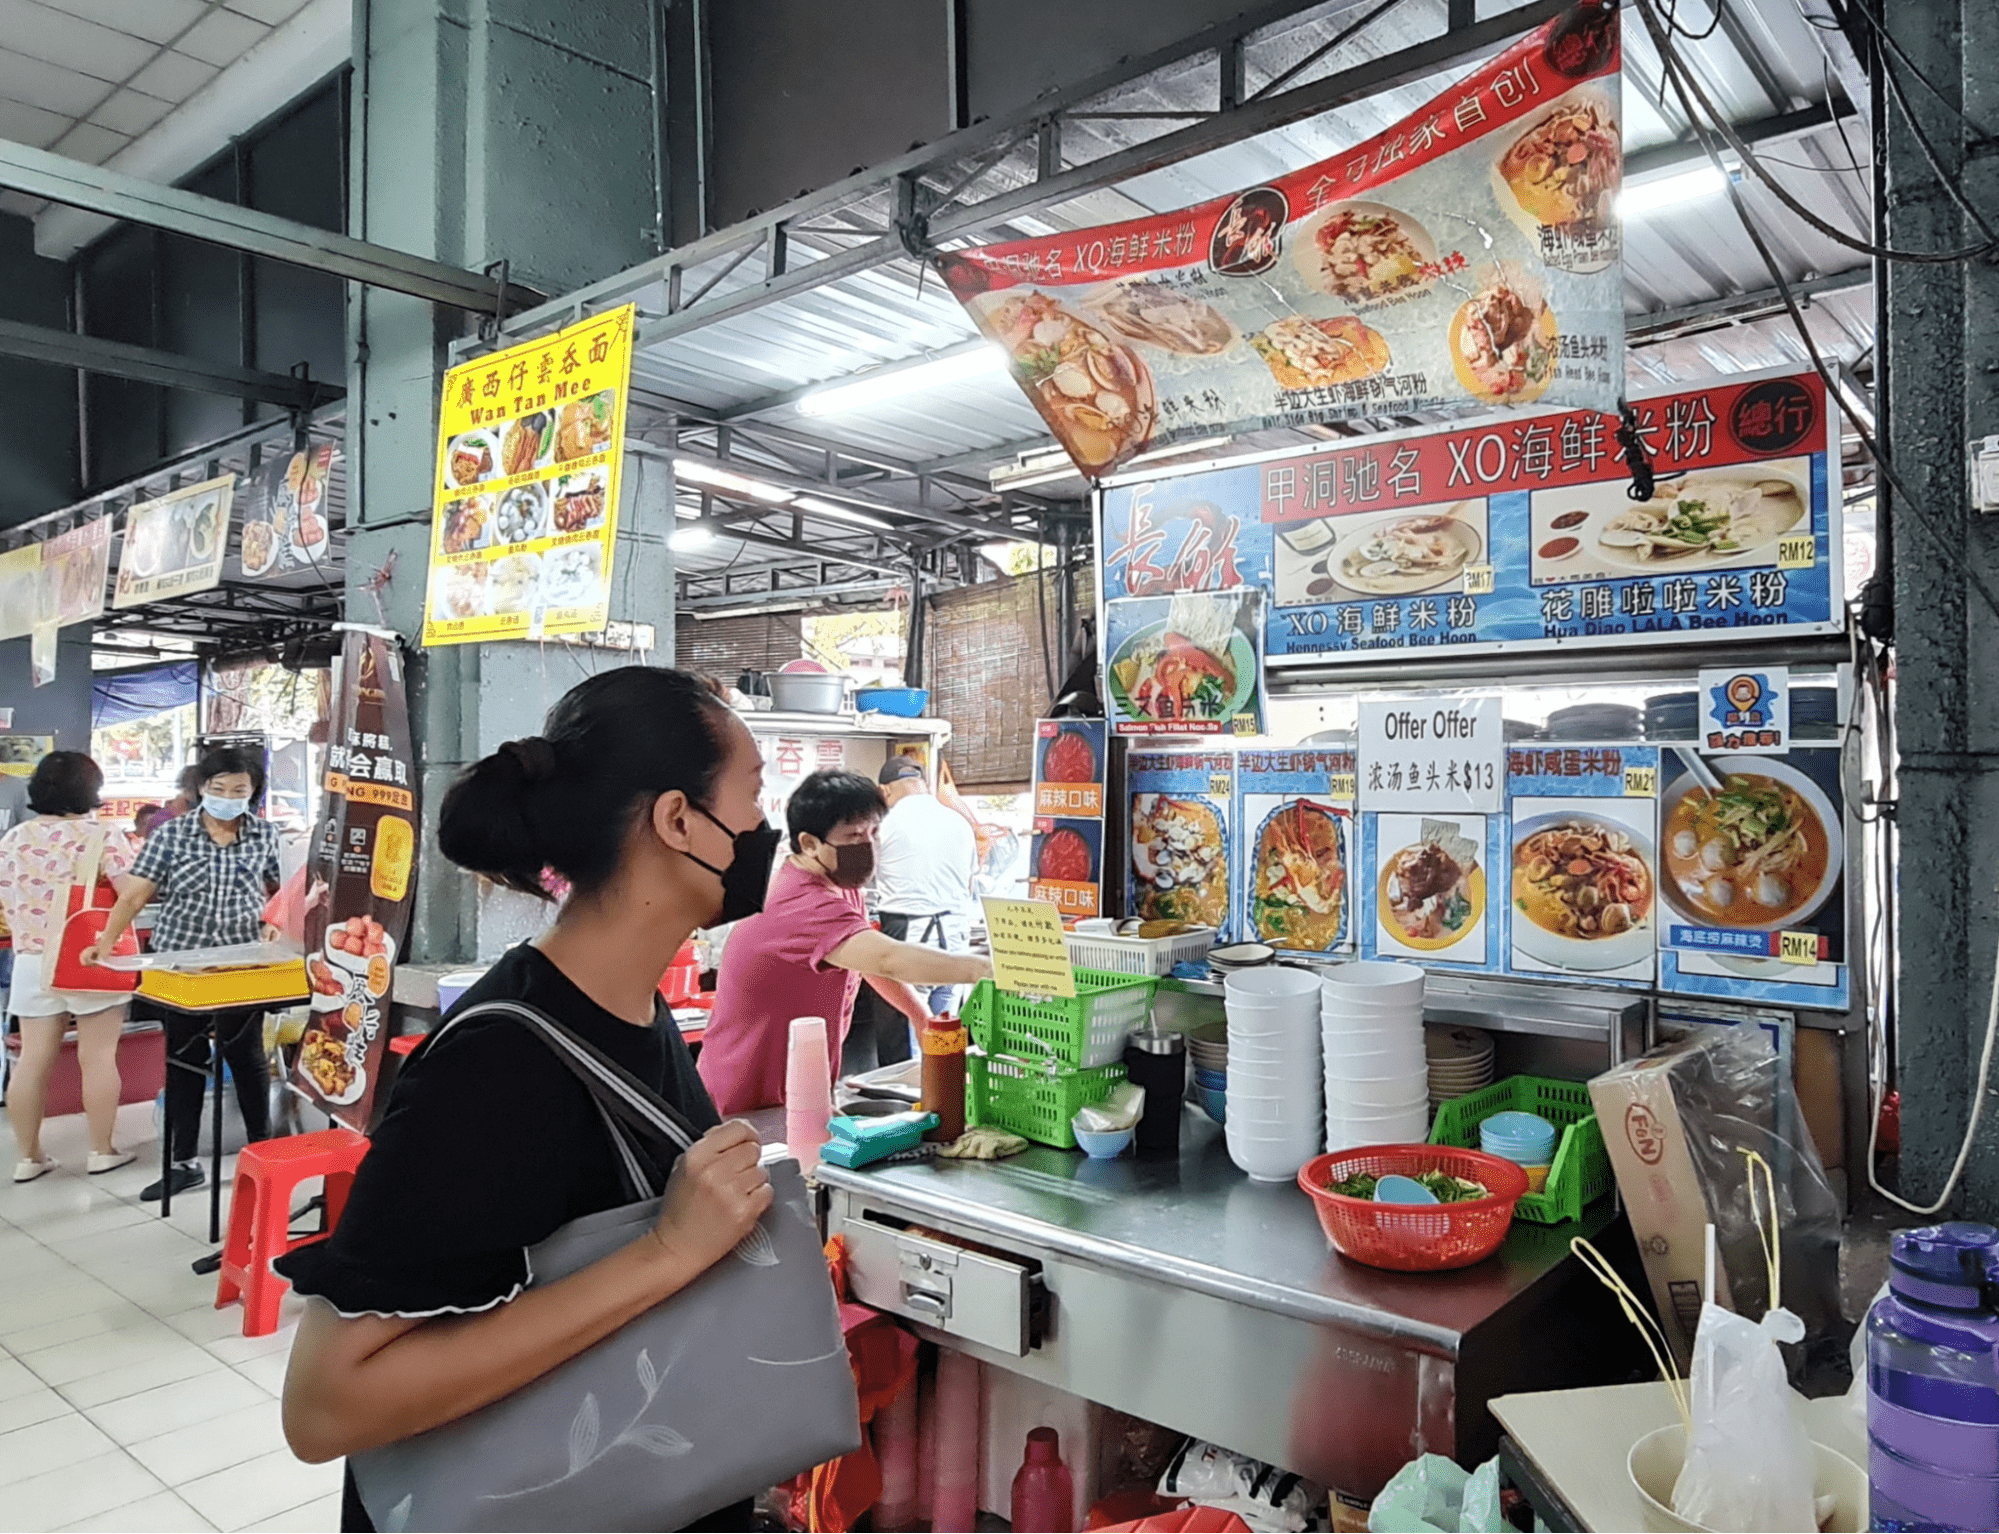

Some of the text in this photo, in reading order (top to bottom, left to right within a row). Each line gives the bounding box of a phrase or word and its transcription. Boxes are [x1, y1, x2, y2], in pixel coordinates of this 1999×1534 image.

[470, 378, 591, 425] Wan Tan Mee
[1267, 446, 1421, 515] 甲洞驰名
[1778, 541, 1814, 561] RM12
[1541, 571, 1787, 622] 花雕啦啦米粉
[1544, 609, 1788, 638] Hua Diao LALA Bee Hoon
[1286, 631, 1477, 654] Hennessy Seafood Bee Hoon
[1232, 717, 1255, 733] RM15
[1385, 709, 1477, 740] Offer Offer
[1508, 748, 1622, 776] 海虾咸蛋米粉
[1331, 778, 1354, 794] RM19
[1625, 771, 1655, 792] RM21
[1040, 788, 1099, 808] 麻辣口味
[1782, 936, 1817, 959] RM14
